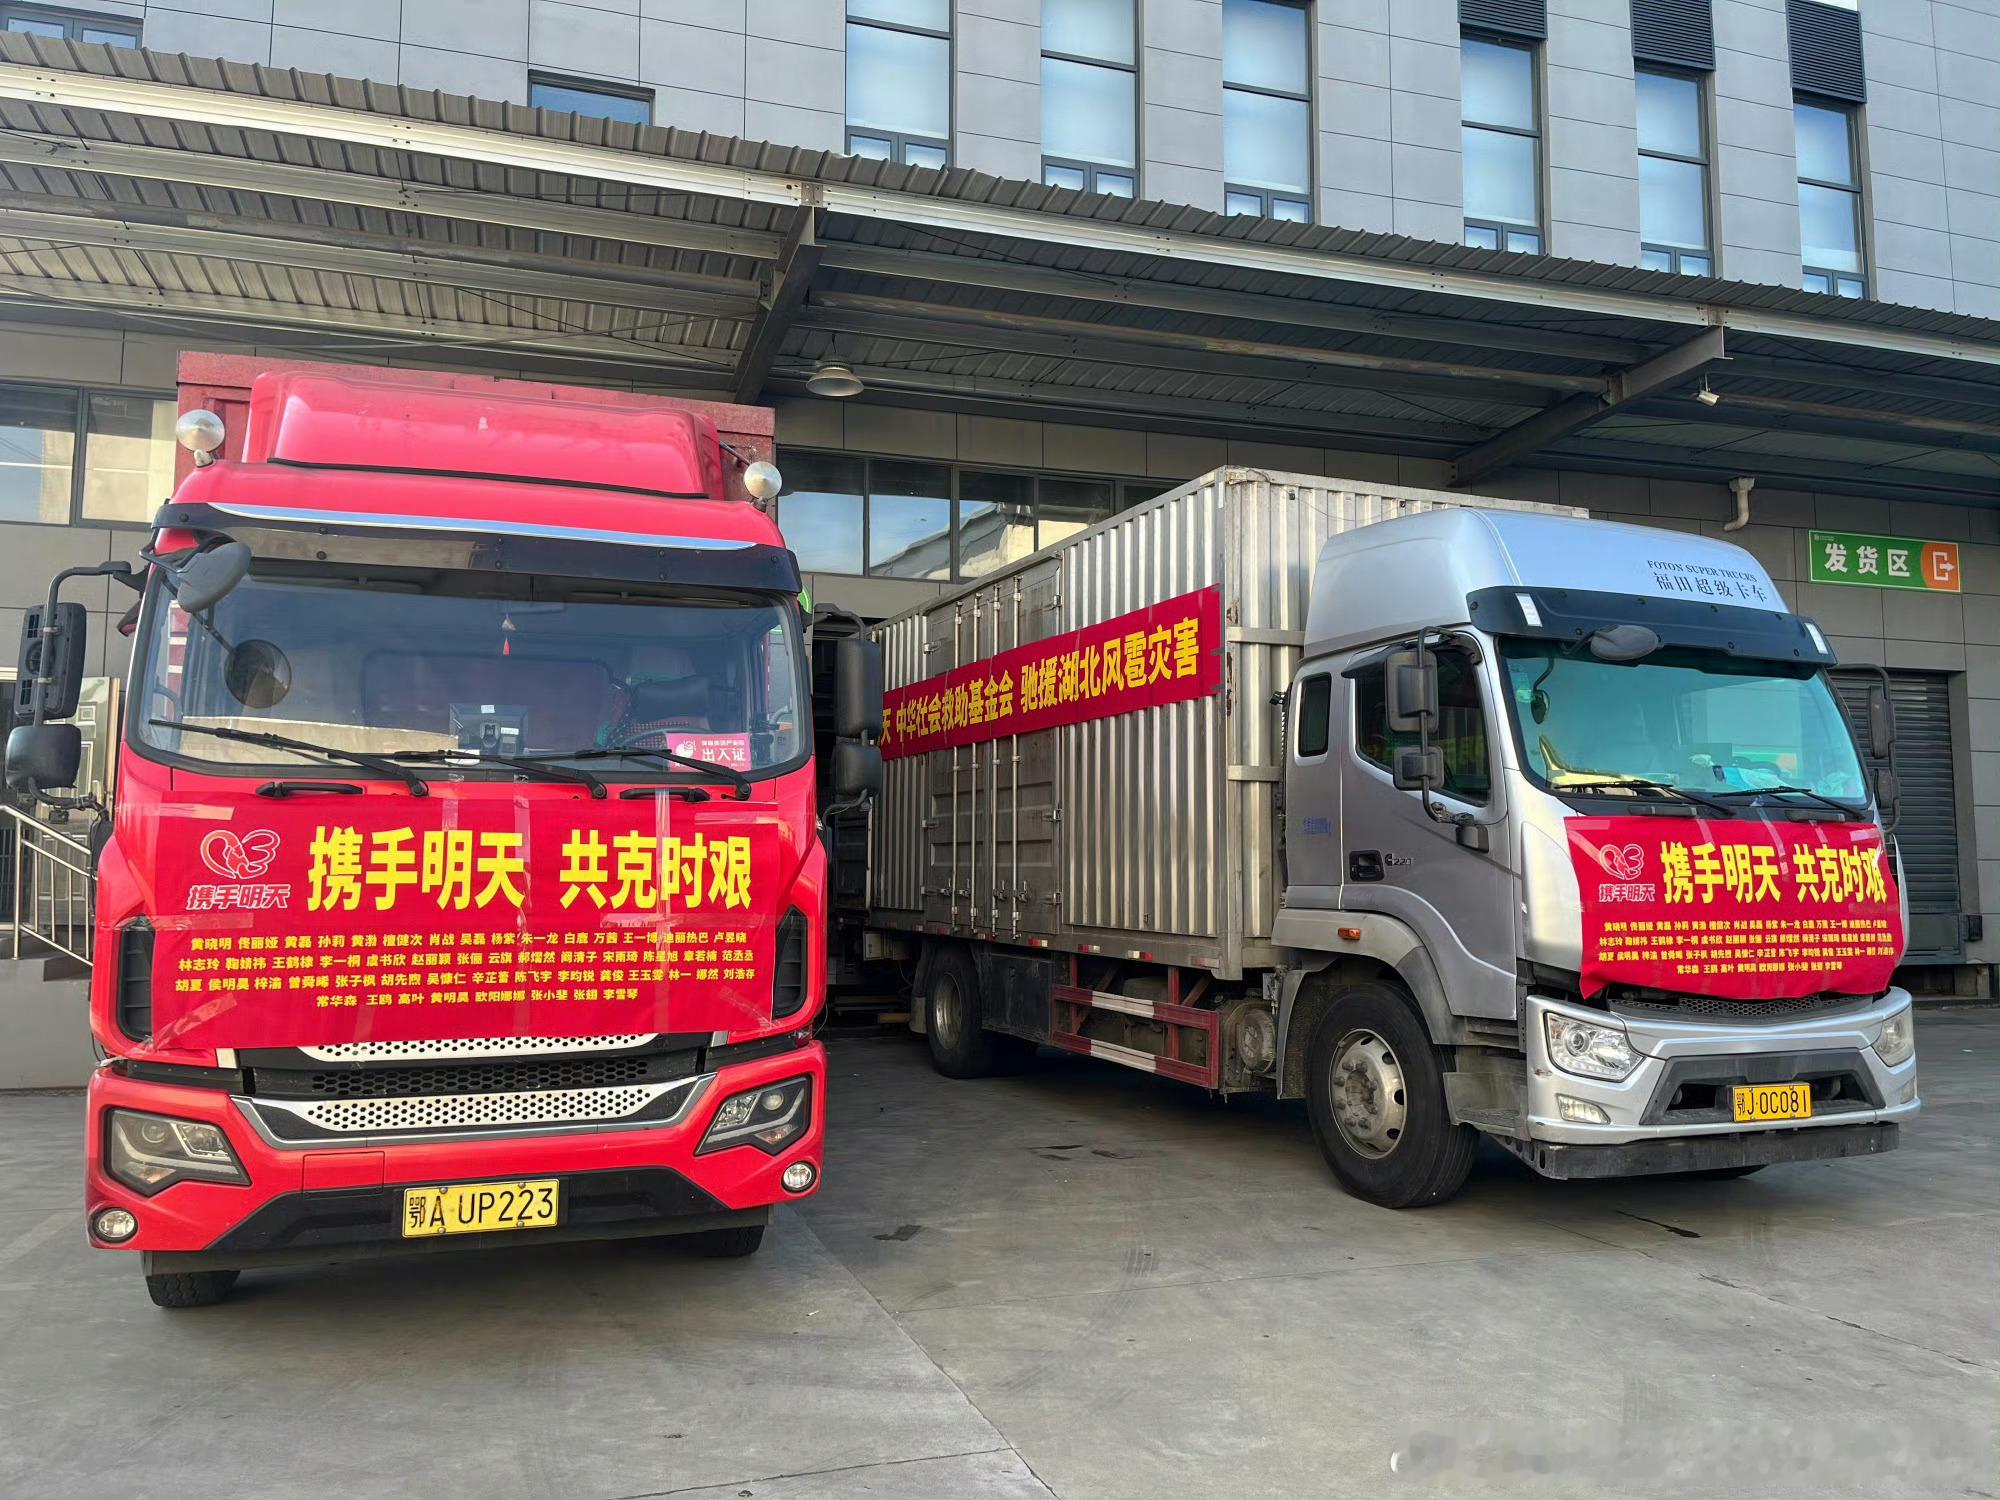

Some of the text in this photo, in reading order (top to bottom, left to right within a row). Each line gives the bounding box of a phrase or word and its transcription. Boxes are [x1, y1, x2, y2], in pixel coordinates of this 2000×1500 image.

[1824, 542, 1911, 577] 发货区
[1647, 560, 1757, 583] FOTON SUPER TRUCKS
[895, 670, 1014, 743] 中华社会救助基金会
[1020, 617, 1200, 713] 驰援湖北风雹灾害
[702, 748, 746, 761] 出入证
[308, 825, 752, 912] 携手明天 共克时艰
[1660, 841, 1888, 904] 携手明天 共克时艰
[186, 883, 291, 911] 携手明天
[1599, 883, 1655, 902] 携手明天
[192, 938, 232, 950] 黄晓明
[238, 937, 278, 949] 佟丽娅
[285, 936, 311, 948] 黄磊
[318, 935, 345, 947] 孙莉
[352, 935, 377, 947] 黄渤
[430, 934, 454, 945] 肖战
[461, 933, 485, 945] 吴磊
[492, 933, 515, 944] 杨紫
[521, 933, 558, 944] 朱一龙
[565, 932, 588, 944] 白鹿
[595, 932, 617, 943] 万茜
[624, 932, 661, 944] 王一博
[661, 930, 708, 946] 迪丽热巴
[179, 958, 220, 971] 林志玲
[320, 955, 360, 967] 李一桐
[412, 953, 451, 965] 赵丽颖
[457, 953, 482, 964] 张俪
[643, 950, 678, 964] 陈星旭
[176, 979, 202, 991] 胡夏
[336, 975, 376, 987] 张子枫
[515, 971, 552, 982] 陈飞宇
[669, 970, 691, 980] 林一
[724, 969, 754, 979] 刘浩存
[317, 995, 357, 1007] 常华森
[368, 994, 392, 1005] 王鸥
[398, 994, 424, 1004] 高叶
[476, 990, 525, 1002] 欧阳娜娜
[604, 989, 638, 1000] 李雪琴
